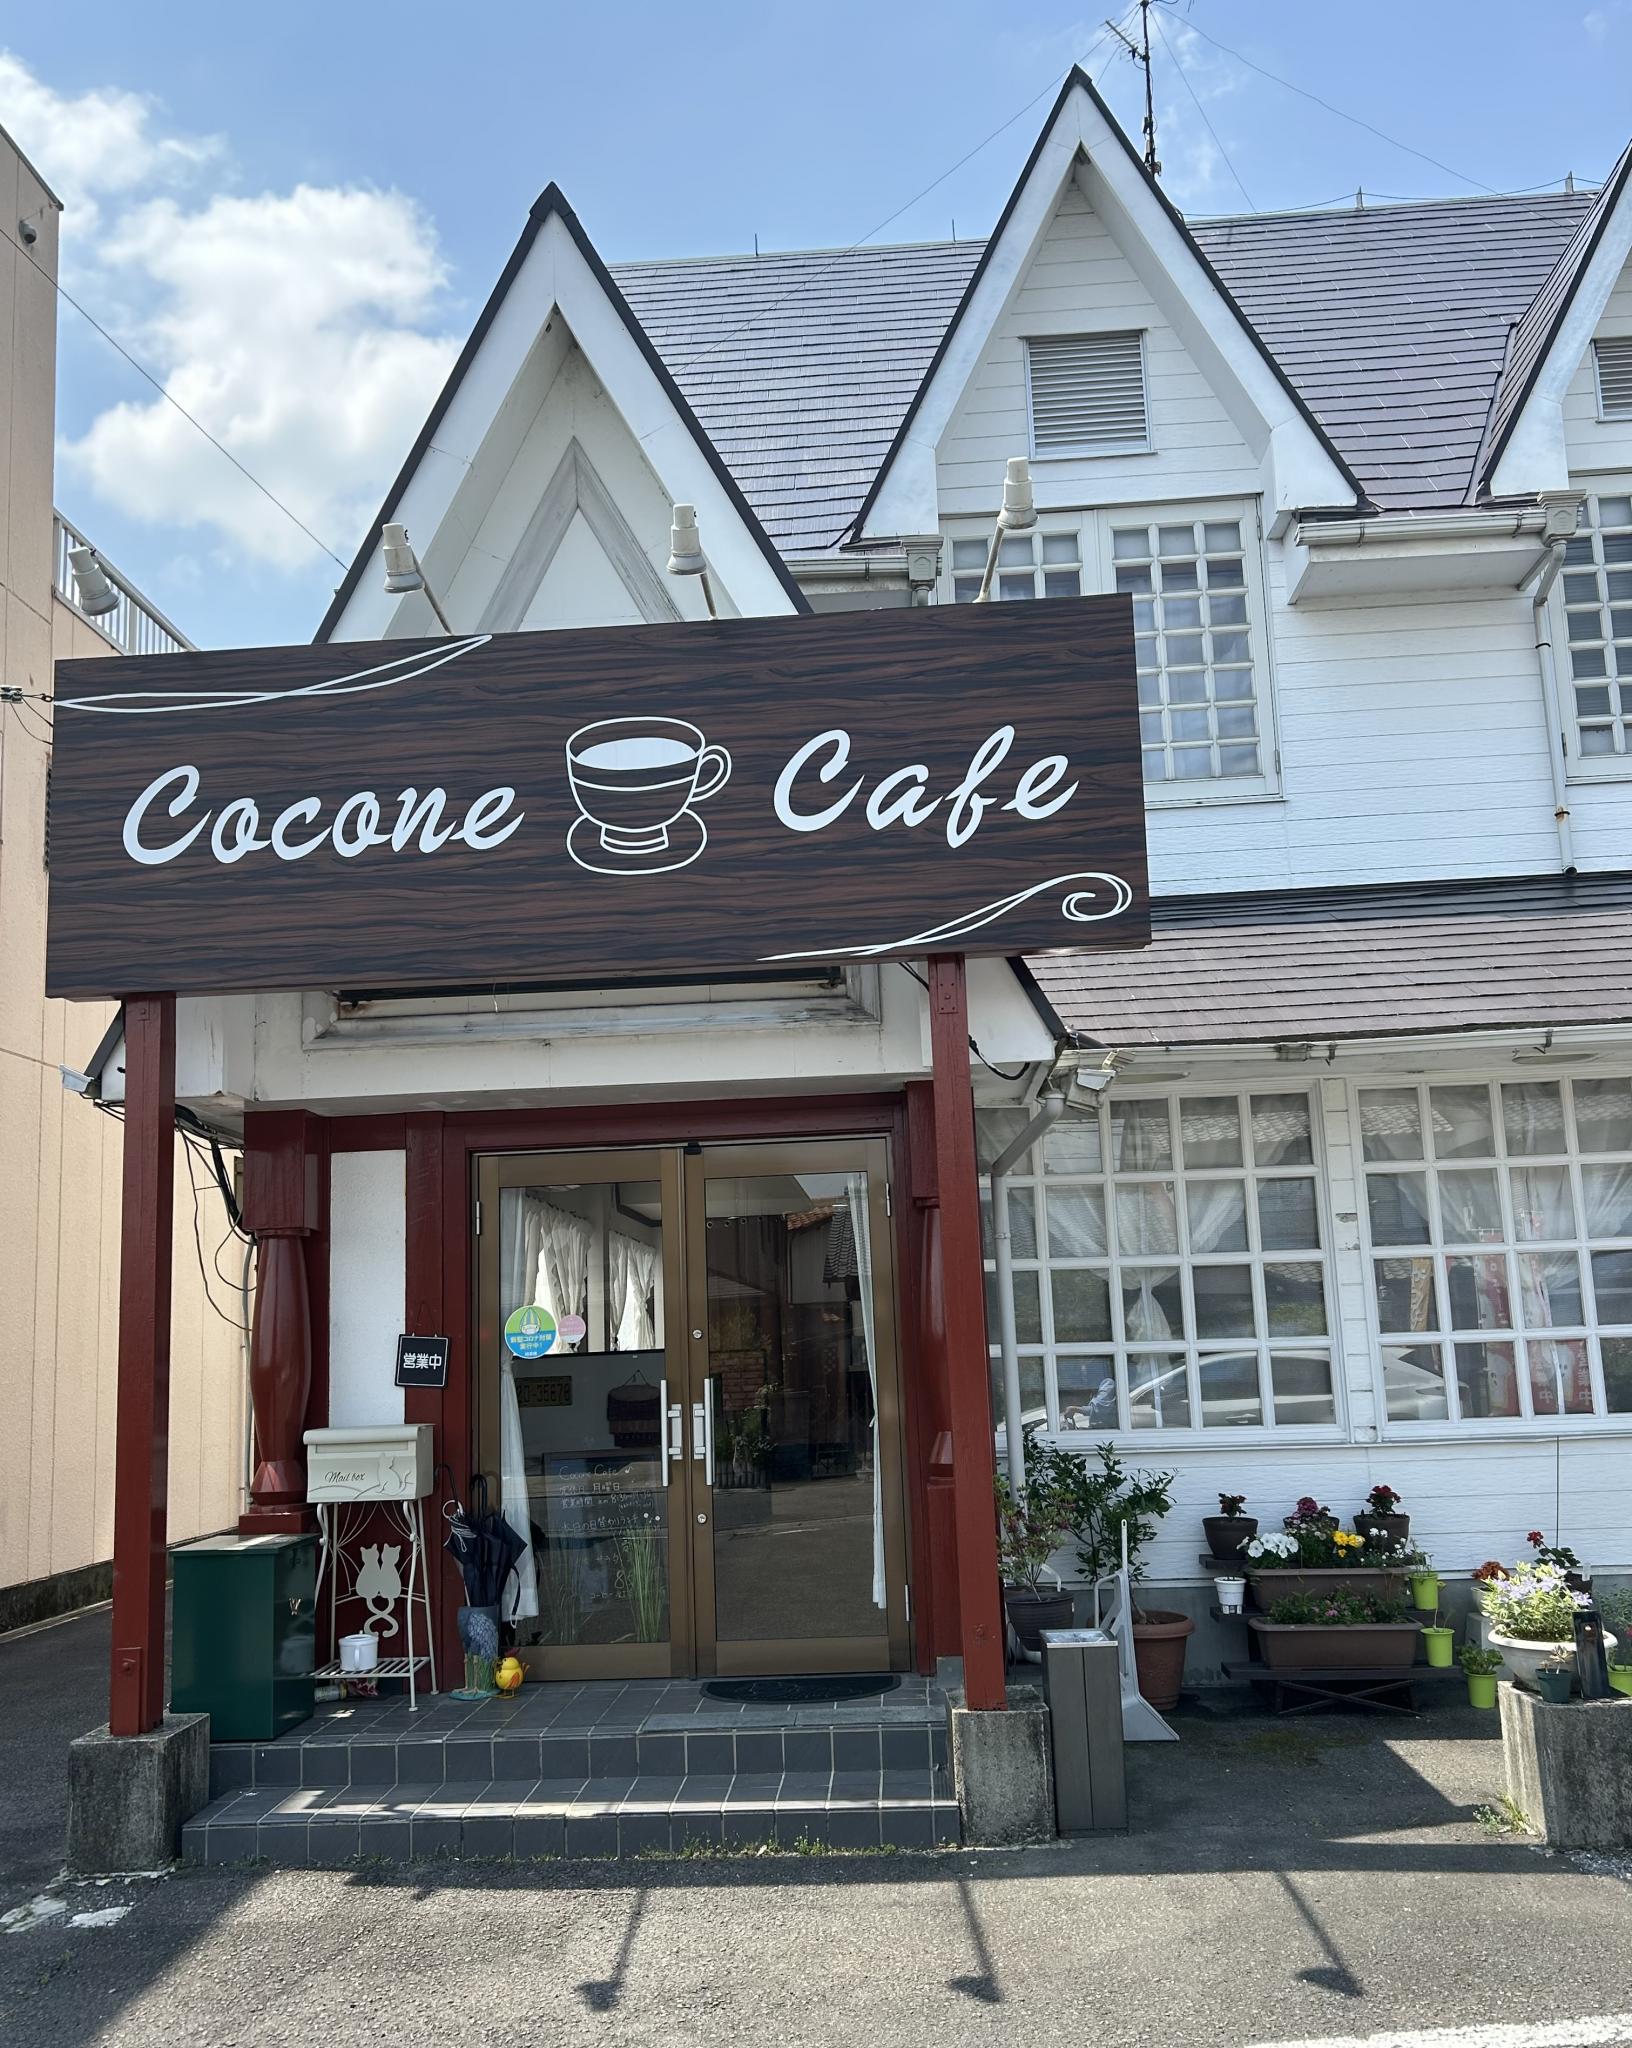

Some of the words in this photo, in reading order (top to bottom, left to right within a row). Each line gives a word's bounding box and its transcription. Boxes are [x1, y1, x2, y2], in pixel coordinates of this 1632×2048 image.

[122, 764, 525, 865] Cocone
[774, 725, 1079, 849] Cafe
[403, 1352, 442, 1370] 営業中
[325, 1471, 350, 1483] Mail
[351, 1472, 366, 1481] box
